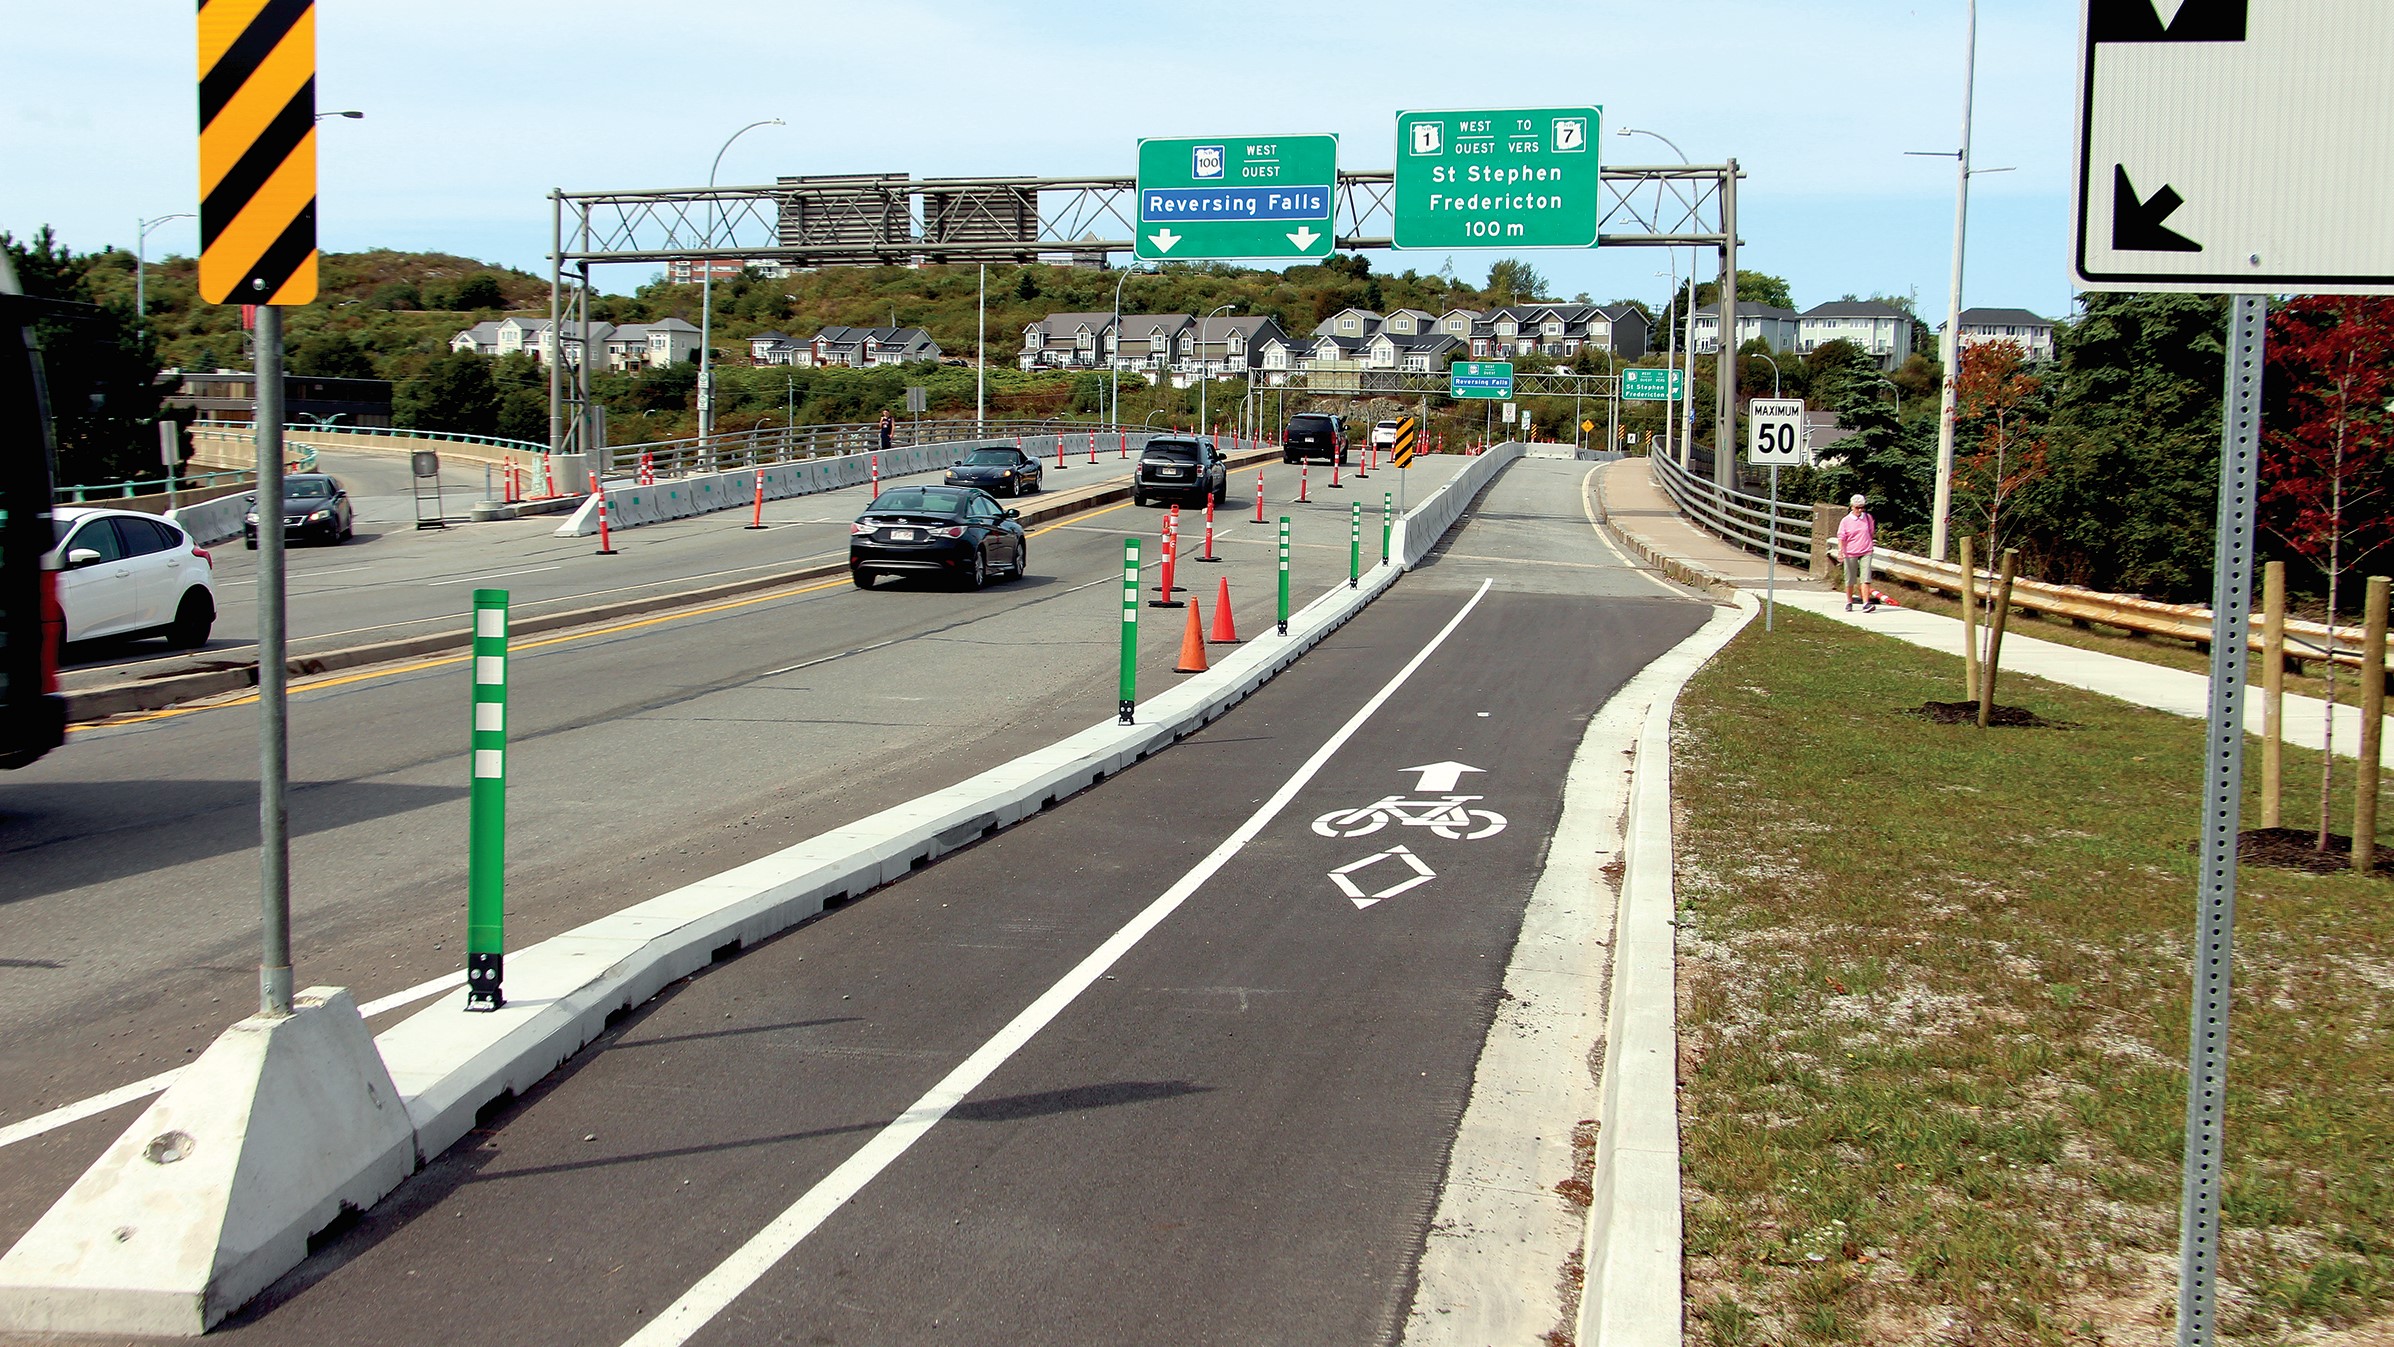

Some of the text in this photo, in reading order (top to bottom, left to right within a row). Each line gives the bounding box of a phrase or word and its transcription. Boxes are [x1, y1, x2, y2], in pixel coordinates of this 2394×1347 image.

[1459, 119, 1532, 132] WEST TO
[1423, 132, 1430, 146] 1
[1563, 129, 1574, 143] 7
[1246, 144, 1277, 156] WEST
[1455, 141, 1539, 154] OUEST VERS
[1199, 157, 1219, 168] 100
[1242, 166, 1280, 178] OUEST
[1432, 165, 1562, 185] St Stephen
[1150, 193, 1321, 216] Reversing Falls
[1429, 193, 1562, 211] Fredericton
[1465, 221, 1524, 237] 100 m
[1455, 378, 1489, 386] Reversing
[1754, 405, 1799, 417] MAXIMUM
[1757, 423, 1795, 455] 50
